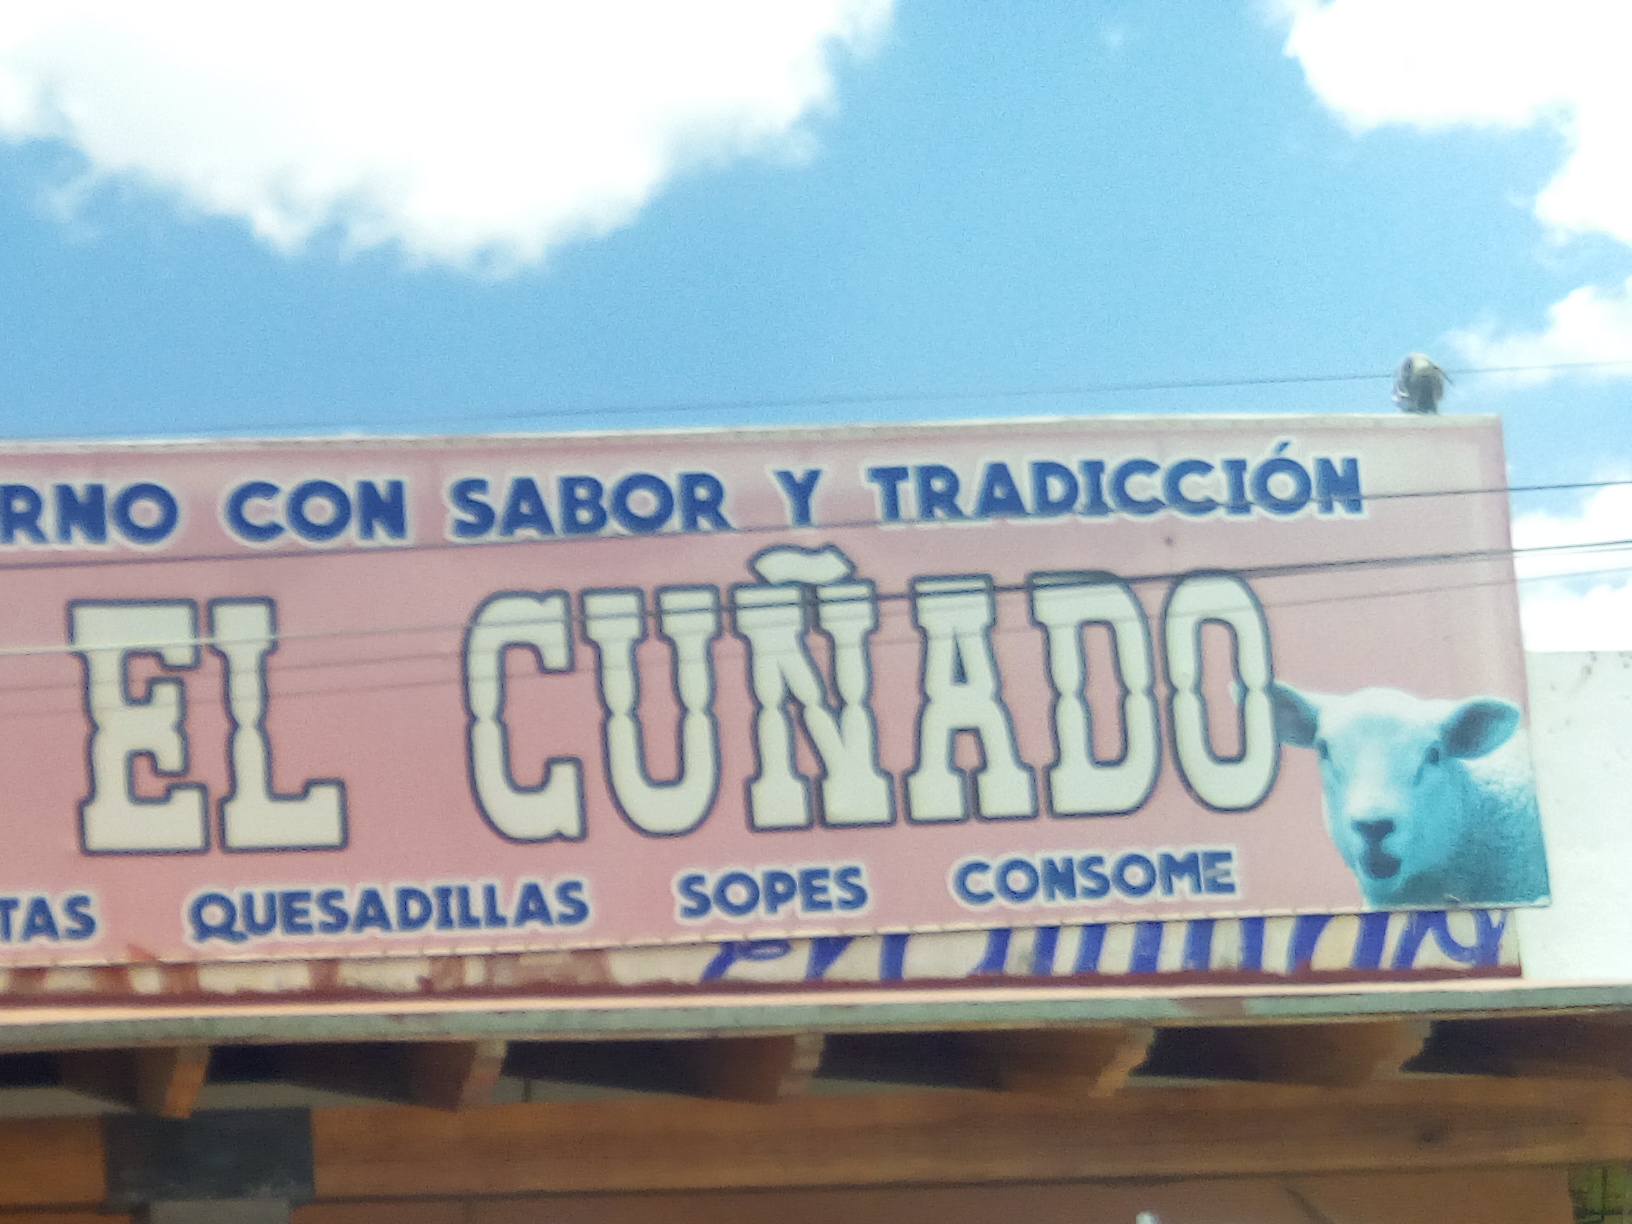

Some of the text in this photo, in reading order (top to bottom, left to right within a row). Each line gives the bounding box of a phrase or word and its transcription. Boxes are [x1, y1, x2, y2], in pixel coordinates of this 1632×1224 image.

[224, 478, 408, 543] CON
[450, 472, 734, 539] SABOR
[770, 469, 823, 526] Y
[867, 440, 1366, 522] TRADICCIÓN
[66, 598, 350, 855] EL
[461, 545, 1282, 844] CUÑADO
[186, 880, 591, 945] QUESADILLAS
[676, 865, 869, 921] SOPES
[953, 850, 1239, 906] CONSOME
